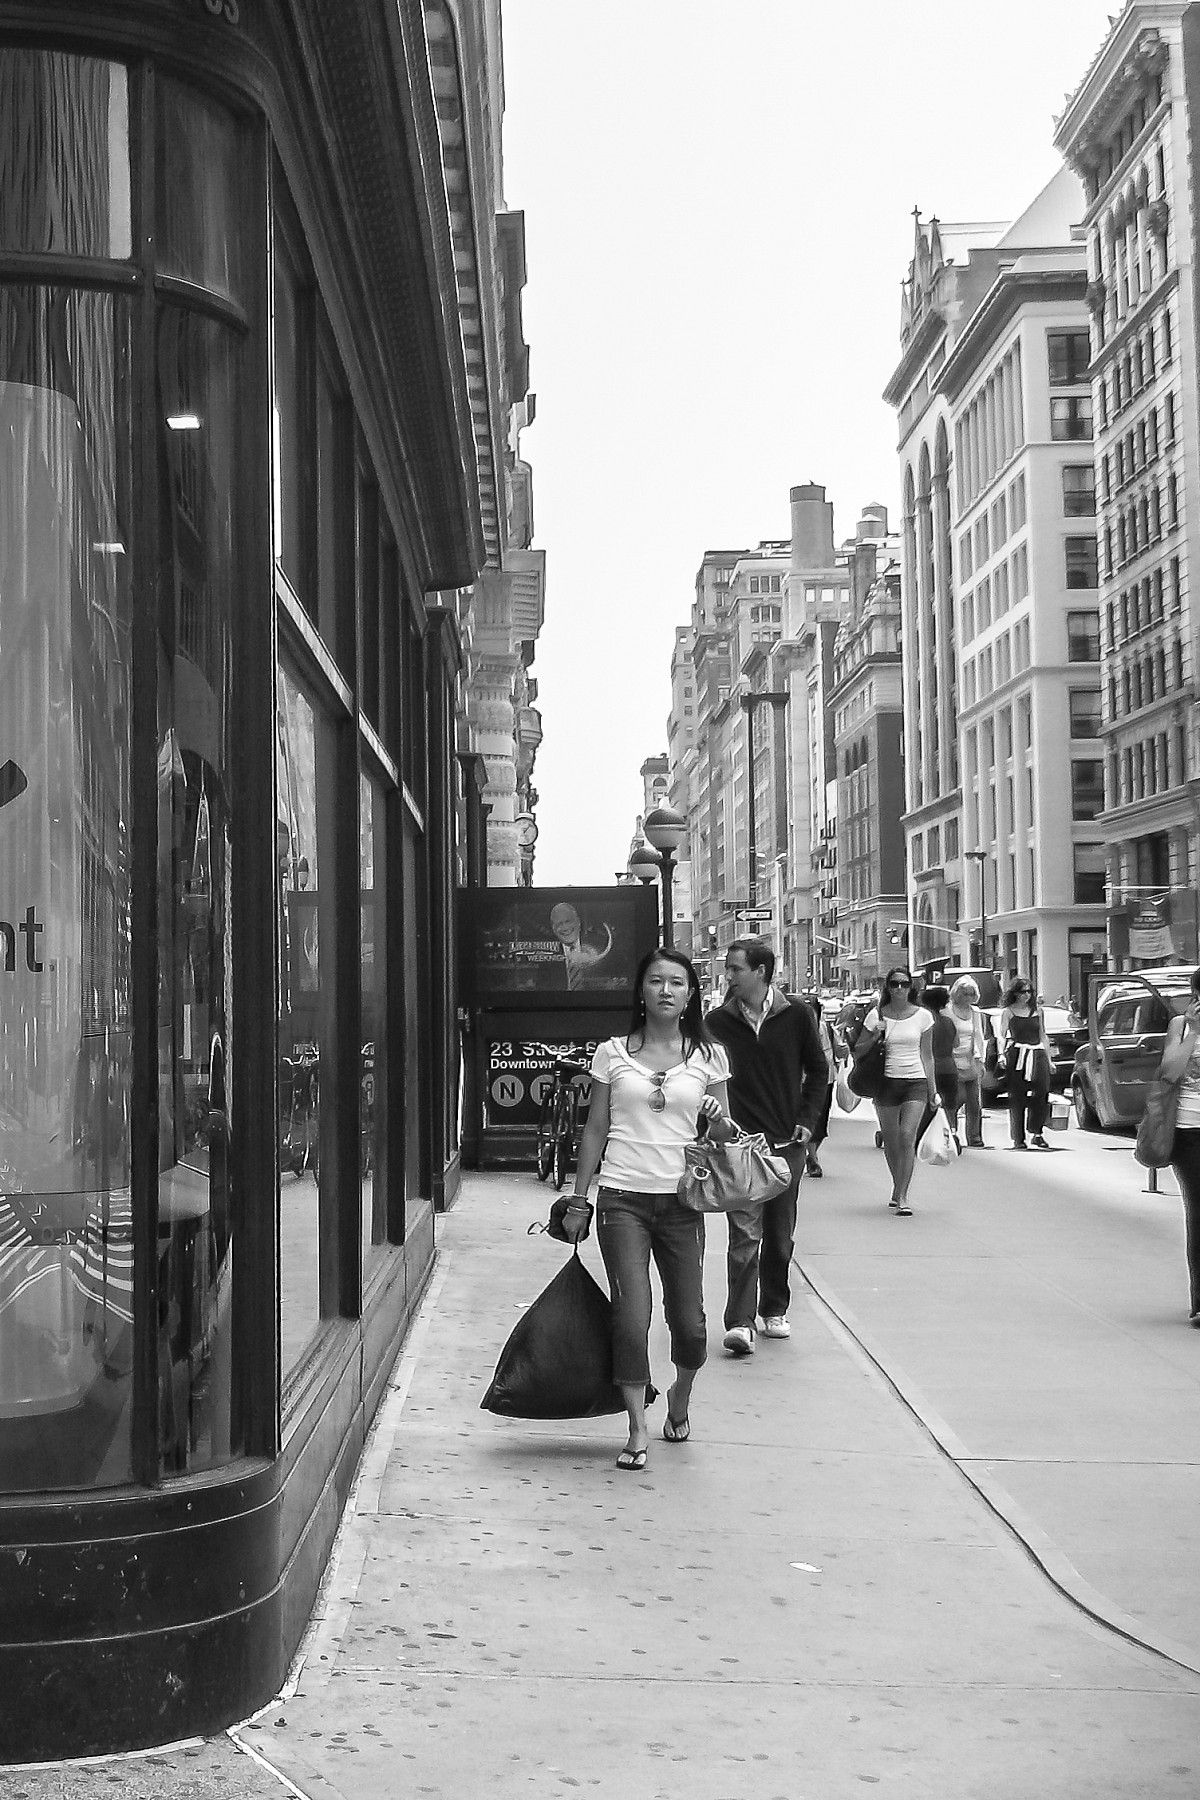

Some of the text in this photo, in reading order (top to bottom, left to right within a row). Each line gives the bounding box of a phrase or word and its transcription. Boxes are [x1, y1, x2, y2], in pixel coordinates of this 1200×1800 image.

[932, 971, 942, 984] P
[490, 1042, 512, 1057] 23
[491, 1058, 555, 1069] Downtown
[500, 1082, 516, 1100] N
